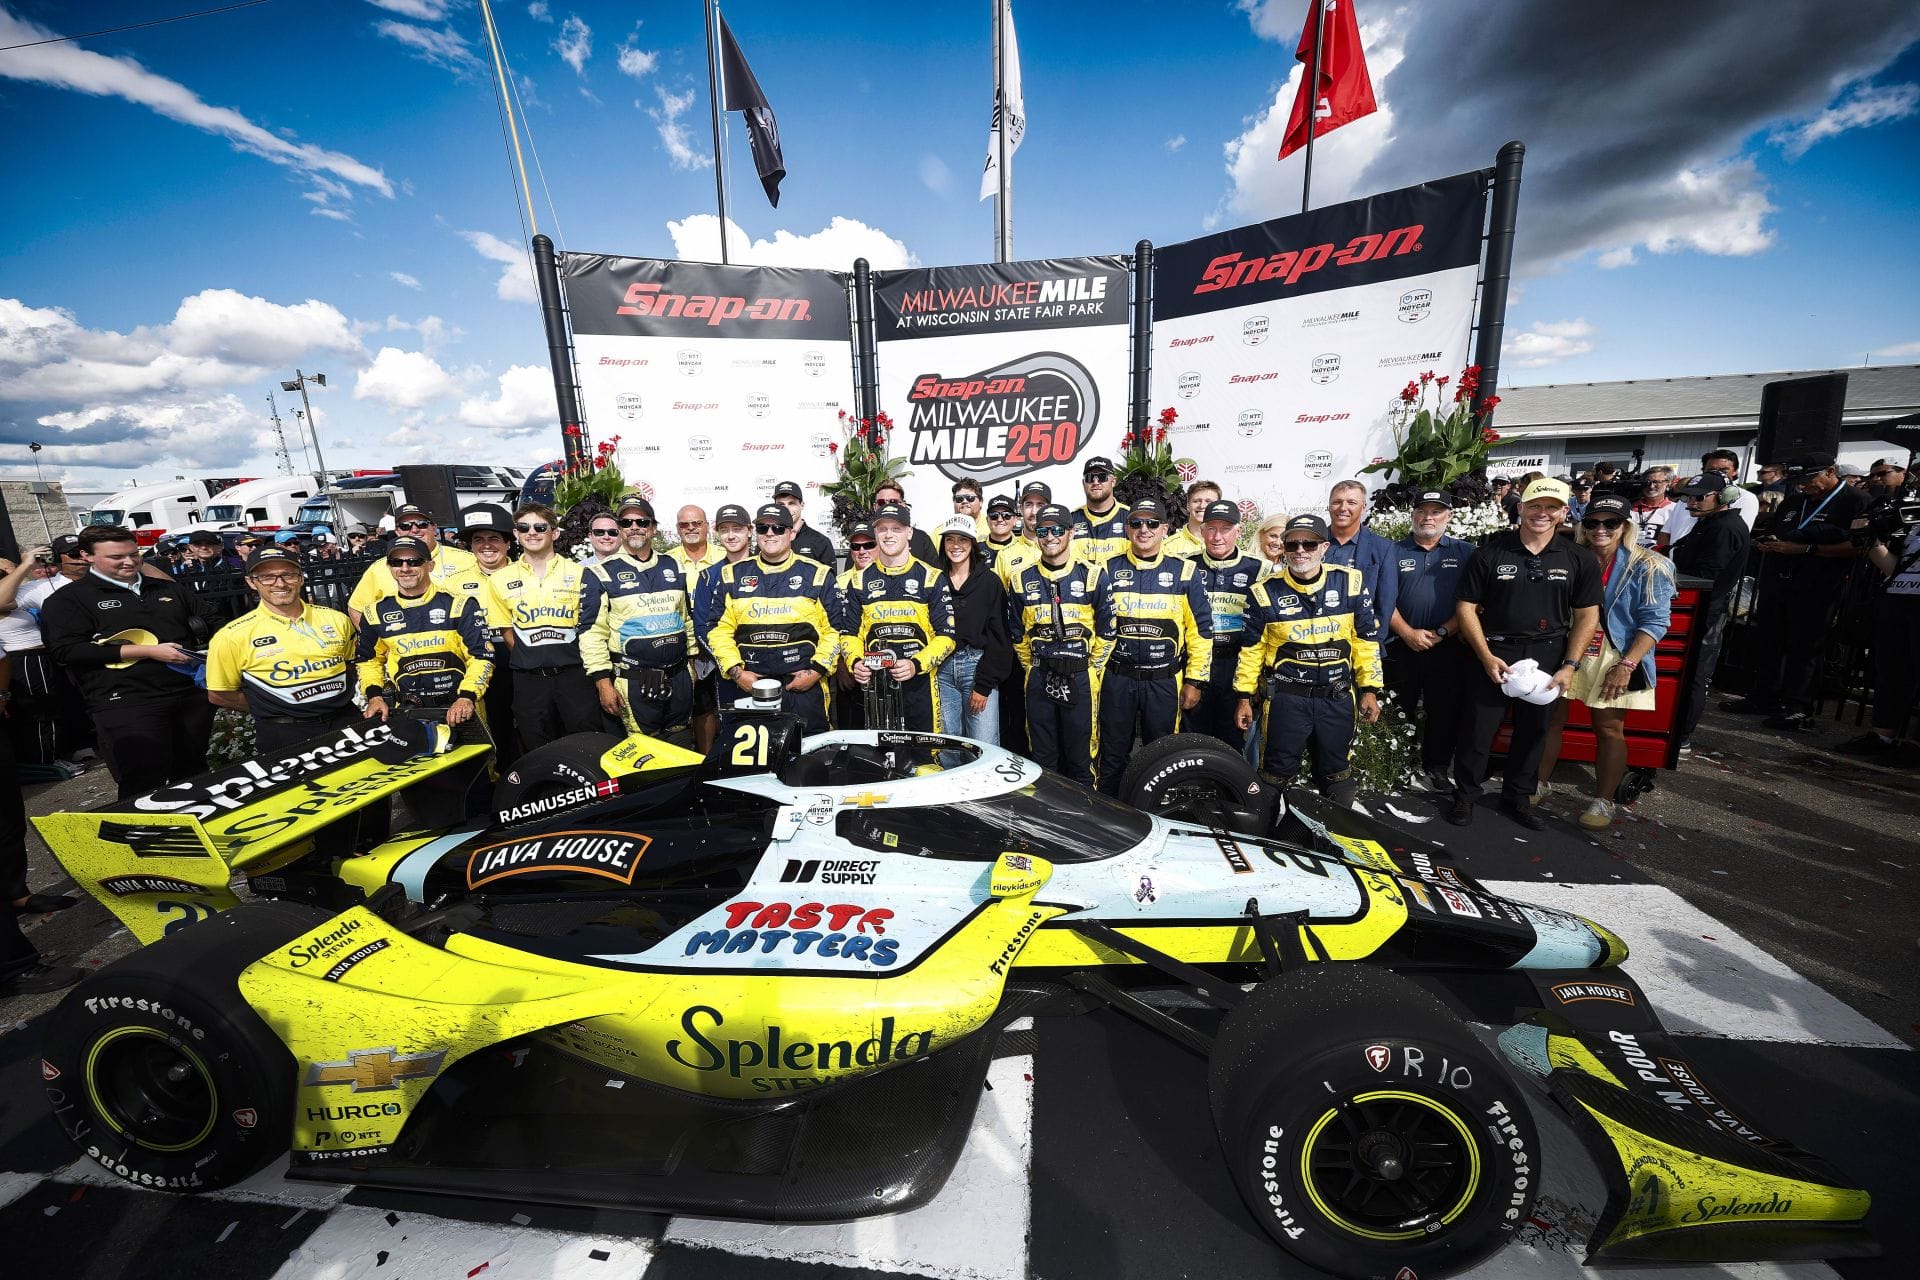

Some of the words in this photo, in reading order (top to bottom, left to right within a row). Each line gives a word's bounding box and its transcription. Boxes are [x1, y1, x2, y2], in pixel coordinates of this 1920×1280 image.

[1193, 225, 1424, 295] Snap-on
[616, 282, 811, 326] Snap-on
[896, 316, 912, 328] AT
[914, 310, 989, 327] WISCONSIN
[994, 307, 1030, 321] STATE
[1035, 304, 1063, 318] FAIR
[1068, 301, 1104, 316] PARK
[1170, 335, 1214, 348] Snap-on
[599, 356, 649, 367] Snap-on
[912, 377, 1025, 400] Snap-on
[1229, 373, 1278, 384] Snap-on
[672, 401, 719, 411] Snap-on
[913, 395, 1070, 428] MILWAUKEE
[1295, 412, 1350, 424] Snap-on
[741, 442, 785, 452] Snap-on
[748, 602, 792, 619] Splenda
[871, 604, 916, 620] Splenda
[1117, 595, 1168, 613] Splenda
[397, 635, 446, 654] Splenda
[1289, 622, 1340, 642] Splenda
[297, 687, 319, 700] JAVA
[320, 682, 344, 692] HOUSE
[731, 724, 769, 766] 21
[881, 732, 912, 741] Splenda
[134, 725, 391, 820] Splenda
[1143, 758, 1204, 793] Firestone
[500, 784, 597, 824] RASMUSSEN
[479, 842, 539, 875] JAVA
[547, 836, 636, 868] HOUSE
[822, 860, 880, 872] DIRECT
[109, 879, 143, 892] JAVA
[147, 879, 202, 893] HOUSE
[821, 872, 877, 885] SUPPLY
[993, 880, 1041, 892] rileykids.org
[725, 902, 895, 934] TASTE
[289, 920, 361, 968] Splenda
[322, 938, 355, 958] STEVIA
[685, 930, 899, 966] MATTERS
[990, 911, 1042, 976] Firestone
[328, 962, 351, 980] JAVA
[350, 941, 385, 962] HOUSE
[1558, 985, 1585, 999] JAVA
[1586, 985, 1627, 999] HOUSE
[84, 996, 205, 1040] Firestone
[667, 1004, 934, 1078] Splenda
[1404, 1047, 1425, 1077] R
[1609, 1030, 1670, 1083] POUR
[751, 1075, 836, 1092] STEV
[1668, 1063, 1716, 1105] HOUSE
[307, 1102, 402, 1120] HURCO
[358, 1131, 381, 1139] NTT
[1714, 1110, 1763, 1140] JAVA
[308, 1147, 388, 1160] Firestone
[1486, 1101, 1530, 1220] Firestone
[88, 1146, 203, 1187] Firestone
[1260, 1125, 1304, 1239] Firestone
[1680, 1192, 1792, 1223] Splenda
